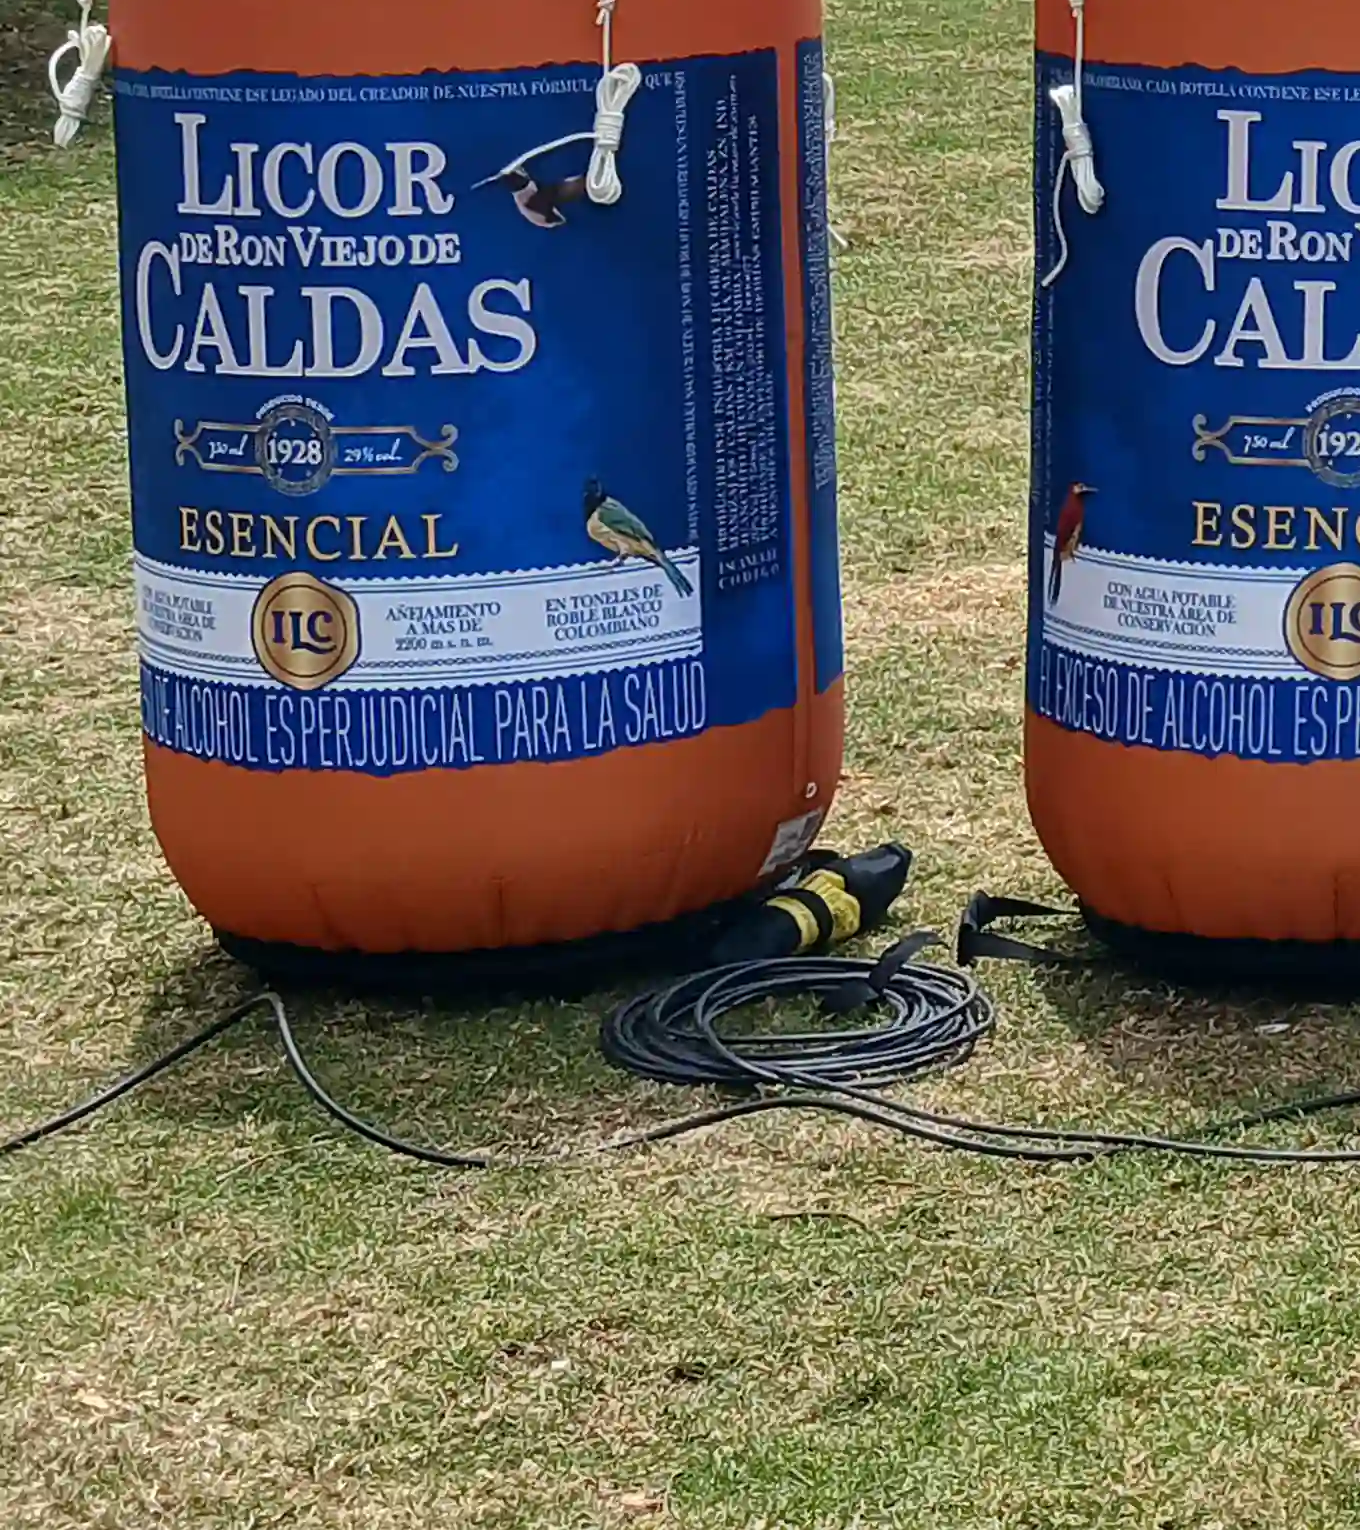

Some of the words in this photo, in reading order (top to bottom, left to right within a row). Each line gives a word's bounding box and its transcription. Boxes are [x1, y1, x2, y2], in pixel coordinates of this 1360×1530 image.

[174, 112, 454, 218] LICOR
[179, 232, 214, 264] DE
[214, 224, 287, 267] RON
[287, 225, 405, 268] VIEJO
[409, 233, 461, 265] DE
[1217, 228, 1262, 259] DE
[1266, 219, 1352, 261] RON
[136, 240, 537, 377] CALDAS
[267, 438, 323, 465] 1928
[178, 506, 459, 561] ESENCIAL
[545, 597, 567, 613] EN
[643, 585, 664, 599] DE
[271, 610, 337, 655] ILC
[461, 618, 484, 634] DE
[554, 615, 660, 641] COLOMBIANO
[175, 681, 258, 764] ALCOHOL
[496, 684, 572, 759] PARA
[581, 676, 616, 750] LA
[626, 661, 707, 744] SALUD
[1056, 652, 1120, 738] EXCESO
[1126, 671, 1154, 745] DE
[1161, 676, 1282, 756] ALCOHOL
